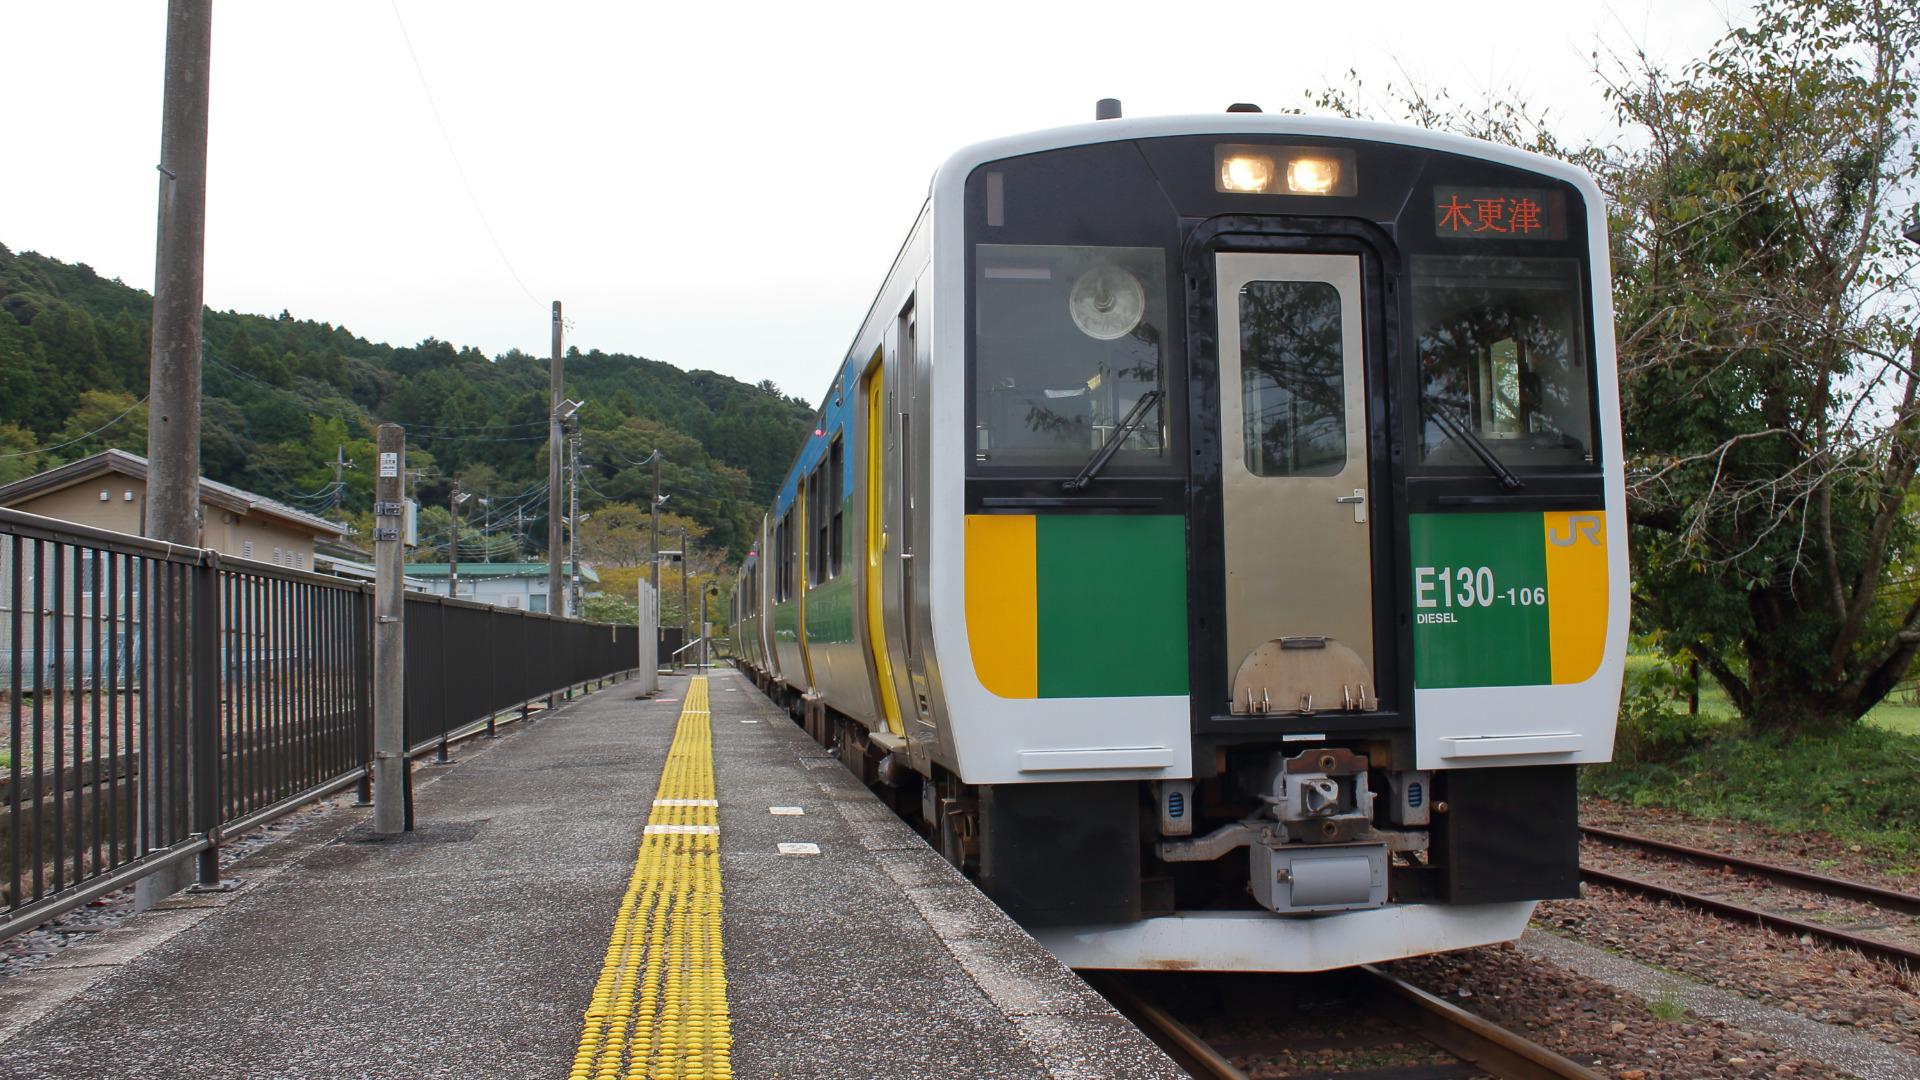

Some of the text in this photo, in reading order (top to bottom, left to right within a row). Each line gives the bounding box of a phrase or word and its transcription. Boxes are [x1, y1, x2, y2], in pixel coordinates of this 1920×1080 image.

[1438, 195, 1542, 234] 木更津
[1549, 514, 1601, 547] JR
[1415, 566, 1546, 608] E130-106
[1416, 612, 1458, 624] DIESEL
